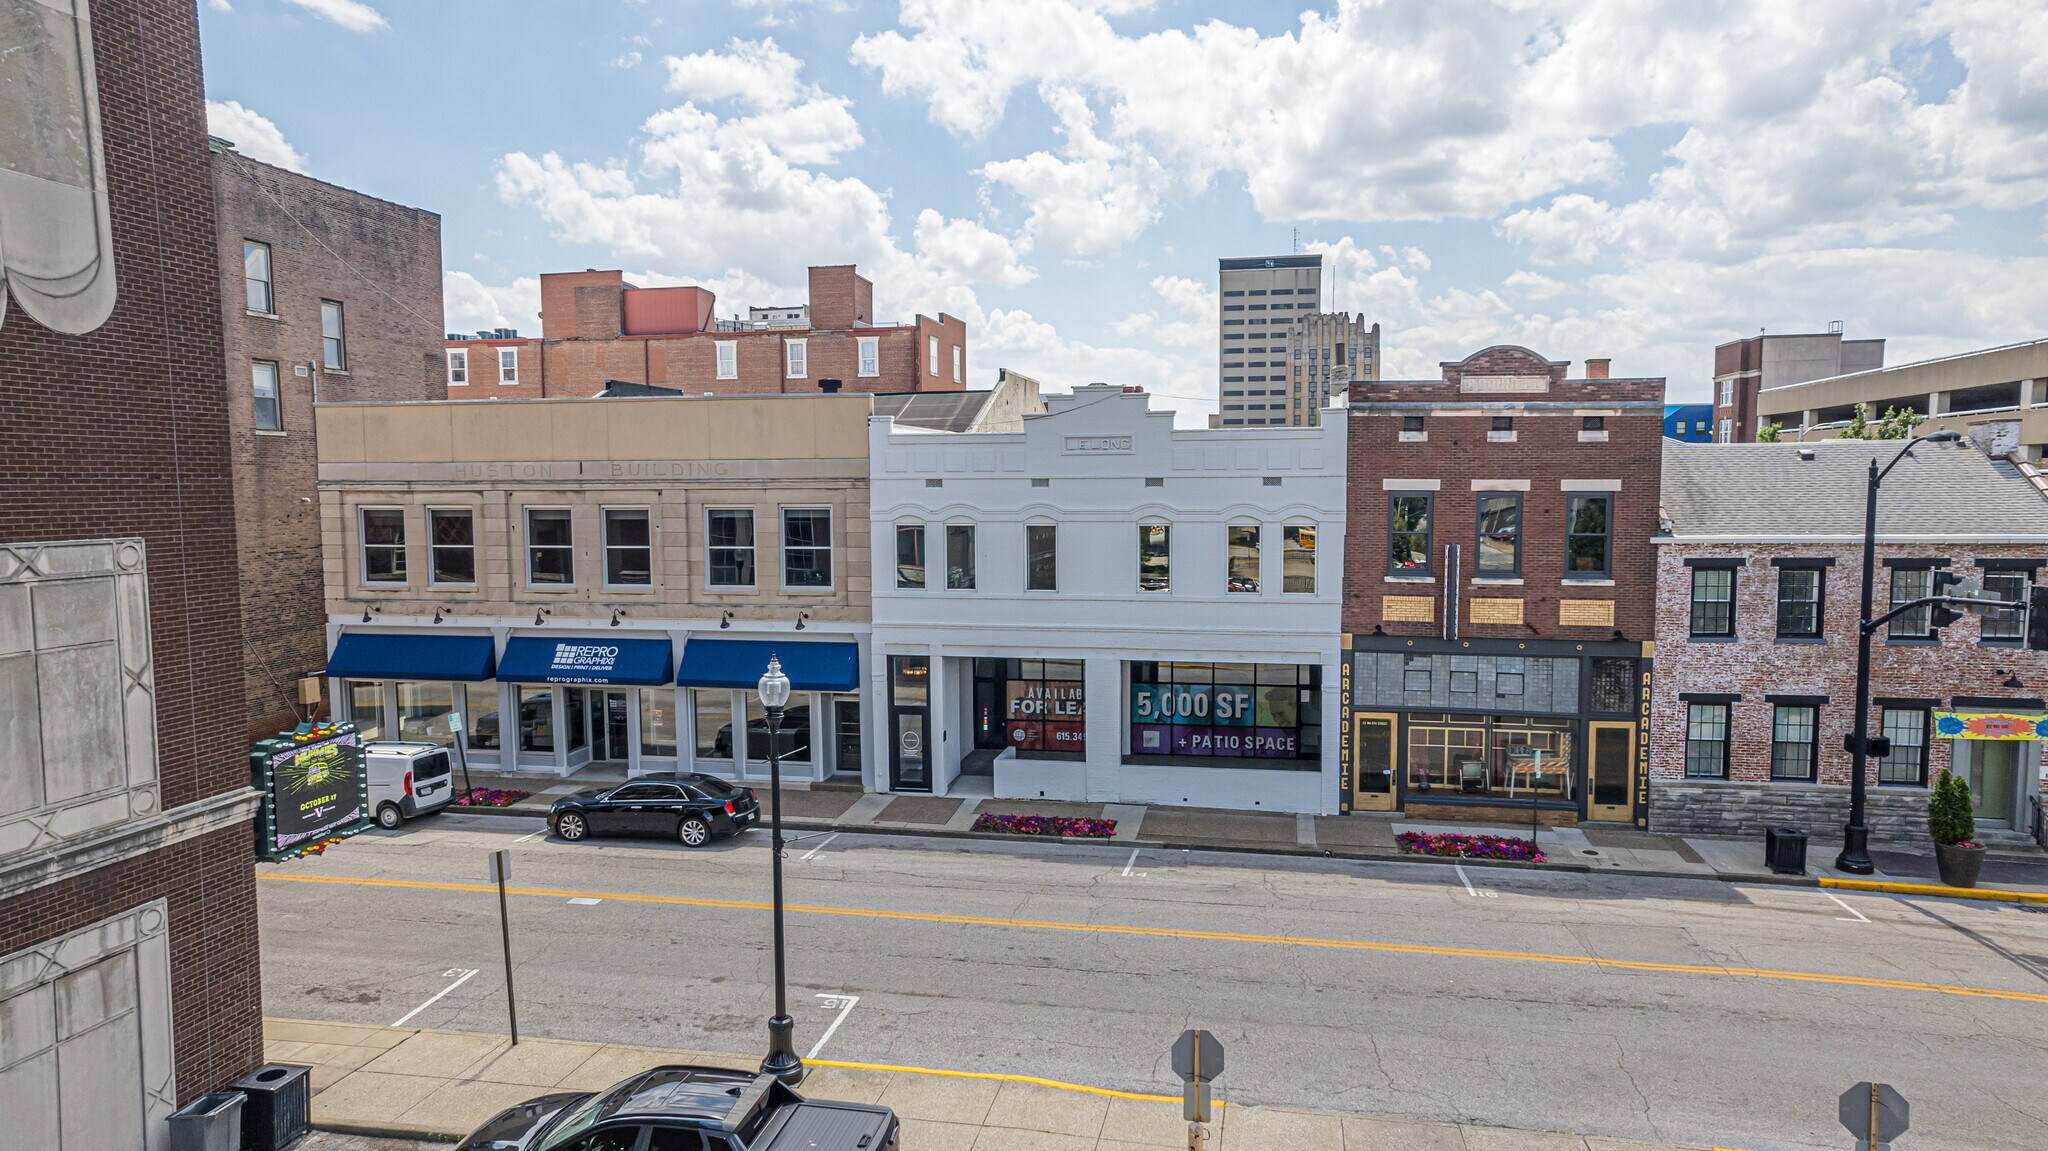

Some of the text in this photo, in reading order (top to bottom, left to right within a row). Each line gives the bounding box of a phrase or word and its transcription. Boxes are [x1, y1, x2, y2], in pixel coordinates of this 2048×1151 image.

[454, 463, 728, 478] HUSTON BUILDING
[576, 646, 618, 657] REPRO
[573, 656, 611, 665] GRAPHIX
[1010, 699, 1048, 714] FOR
[1137, 691, 1249, 720] 5,000 SF
[1341, 663, 1350, 790] ARCADEMIE
[1192, 734, 1240, 749] PATIO
[1245, 735, 1295, 751] SPACE
[1638, 672, 1651, 804] ARCADEMIE
[300, 796, 330, 811] OCTOBER
[330, 793, 337, 801] 17
